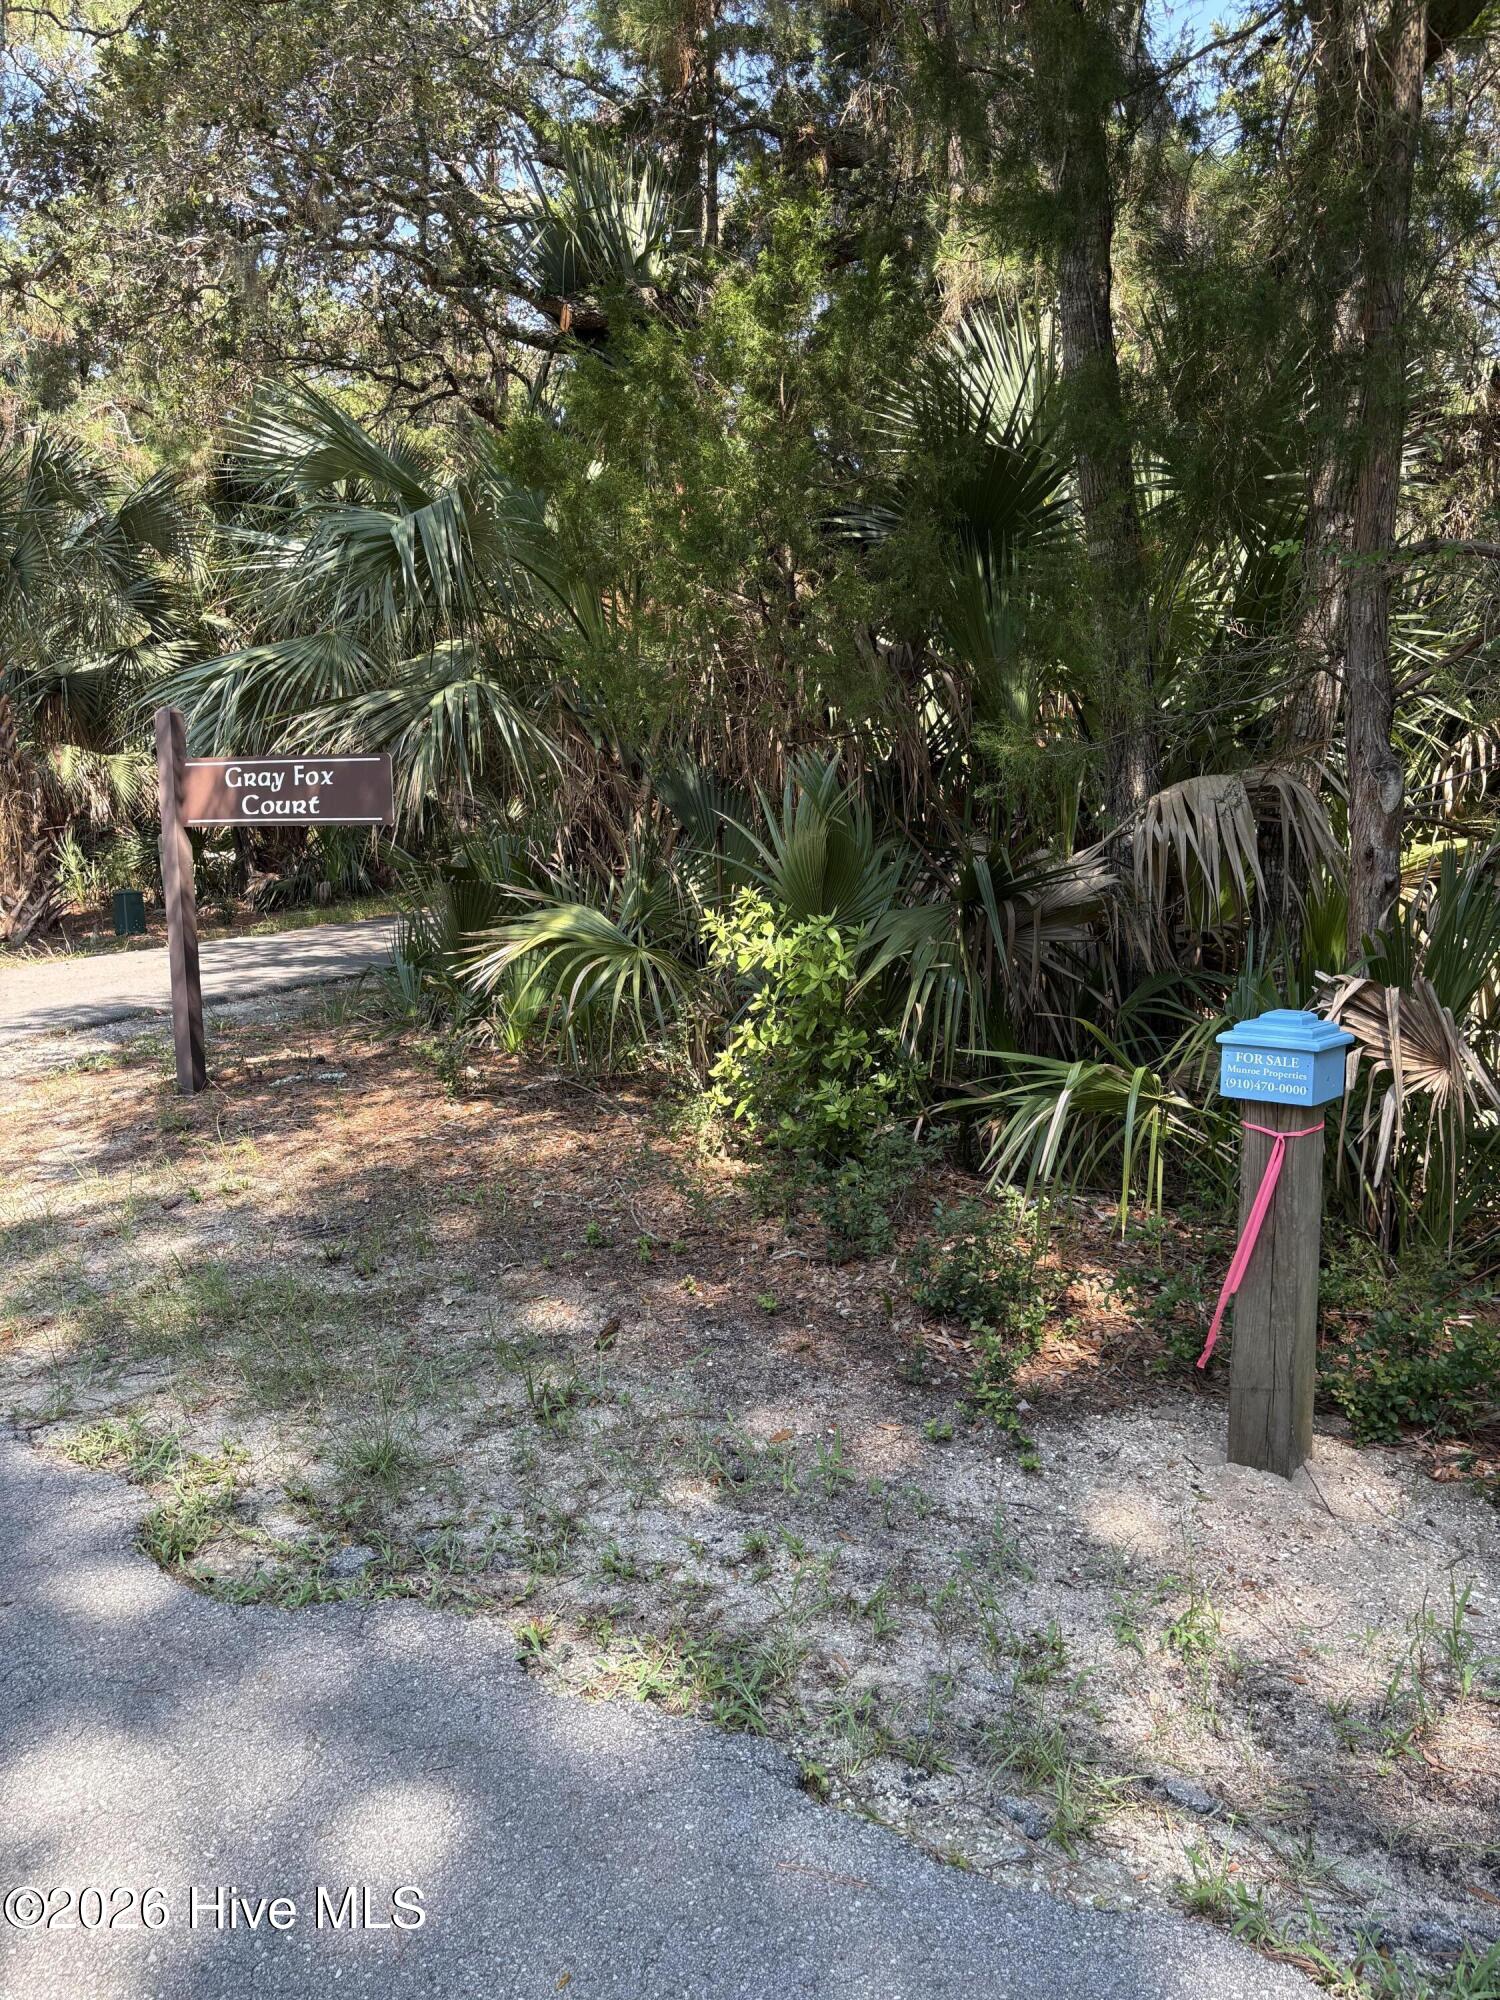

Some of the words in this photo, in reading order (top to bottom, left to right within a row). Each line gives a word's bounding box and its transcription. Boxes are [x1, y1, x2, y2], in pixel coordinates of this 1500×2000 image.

[225, 767, 285, 792] Gray
[294, 765, 334, 785] Fox
[242, 794, 320, 815] Court
[1236, 1052, 1263, 1064] FOR
[1266, 1055, 1300, 1068] SALE
[1227, 1064, 1260, 1076] Munroe
[1263, 1067, 1307, 1081] Properties
[1225, 1077, 1307, 1096] (910)470-0000
